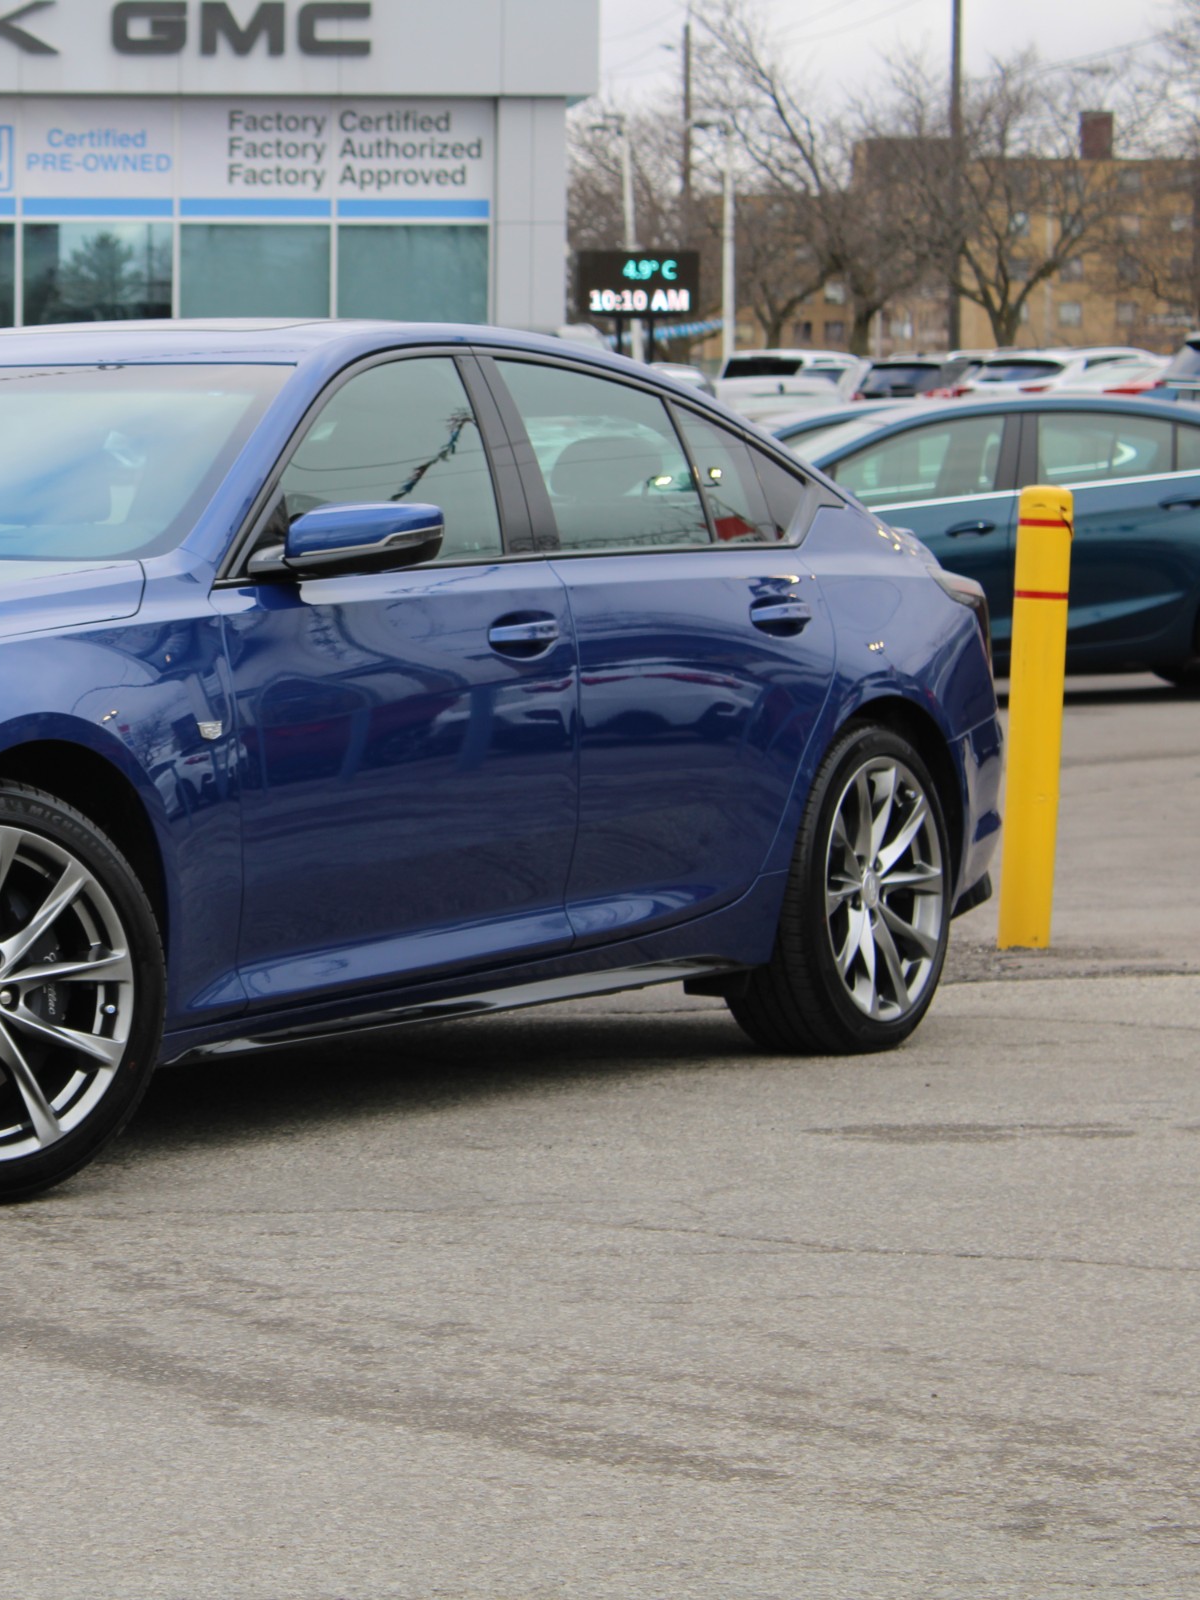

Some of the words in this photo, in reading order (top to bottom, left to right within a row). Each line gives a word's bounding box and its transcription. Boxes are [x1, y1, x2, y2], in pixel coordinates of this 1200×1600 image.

[111, 0, 371, 57] GMC
[47, 128, 147, 148] Certified
[228, 110, 327, 138] Factory
[339, 110, 451, 132] Certified
[26, 153, 173, 172] PRE-OWNED
[228, 136, 327, 165] Factory
[339, 137, 483, 159] Authorized
[228, 163, 327, 192] Factory
[339, 164, 466, 191] Approved
[589, 289, 648, 311] 10:10
[651, 289, 690, 311] AM
